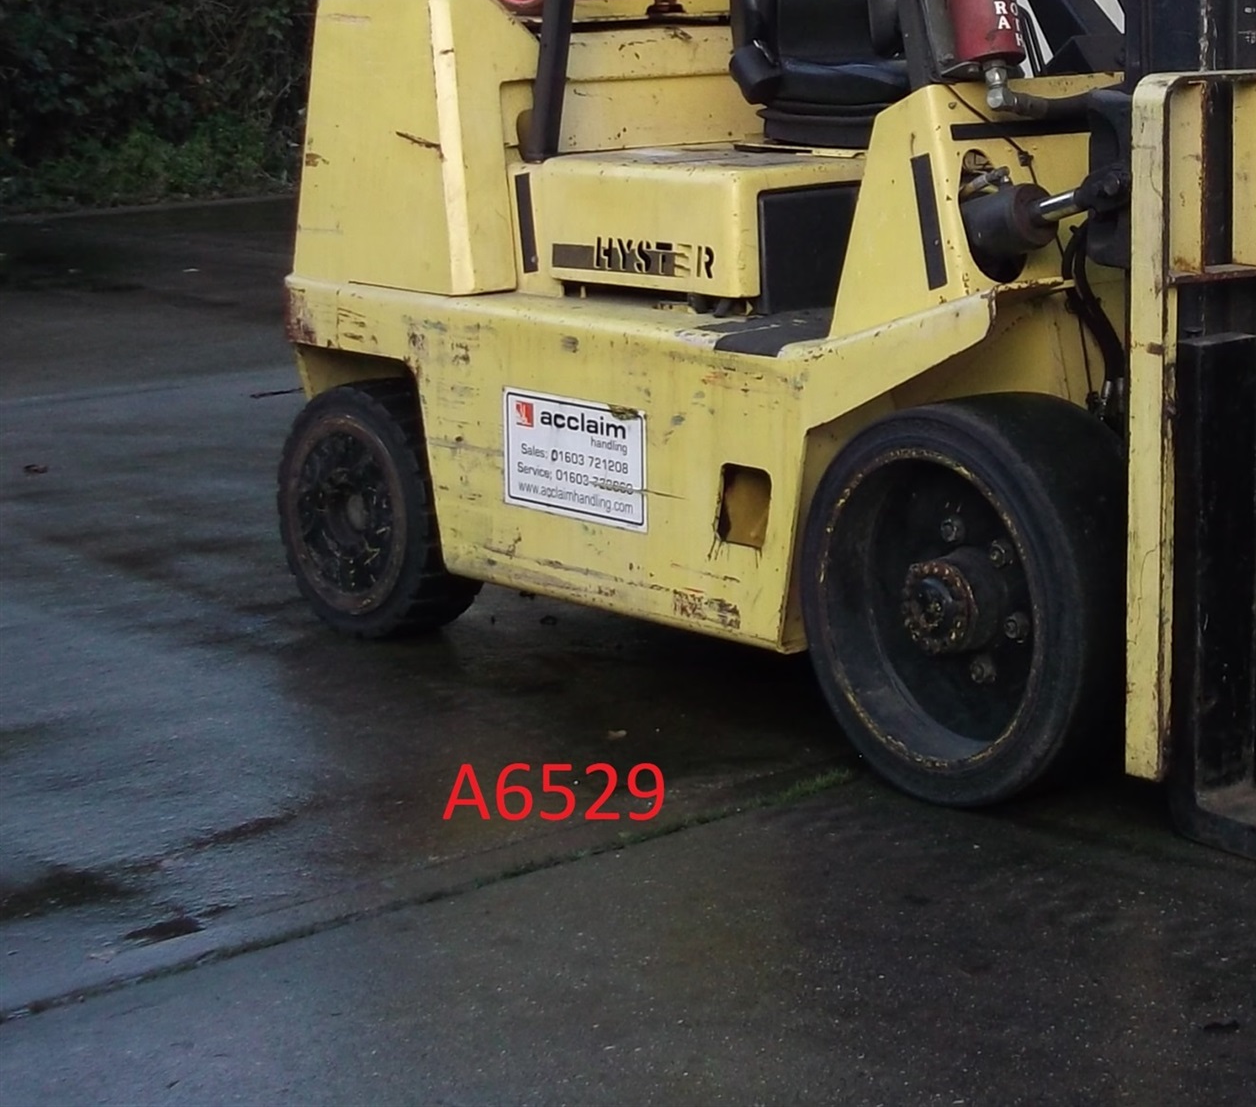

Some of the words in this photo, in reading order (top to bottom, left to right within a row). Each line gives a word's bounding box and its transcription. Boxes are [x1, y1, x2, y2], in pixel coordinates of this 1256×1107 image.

[593, 236, 715, 280] HYSTER
[540, 411, 626, 439] acclaim
[590, 436, 628, 456] handling
[551, 449, 585, 466] 01603
[588, 456, 629, 474] 721208
[555, 469, 589, 486] 01603
